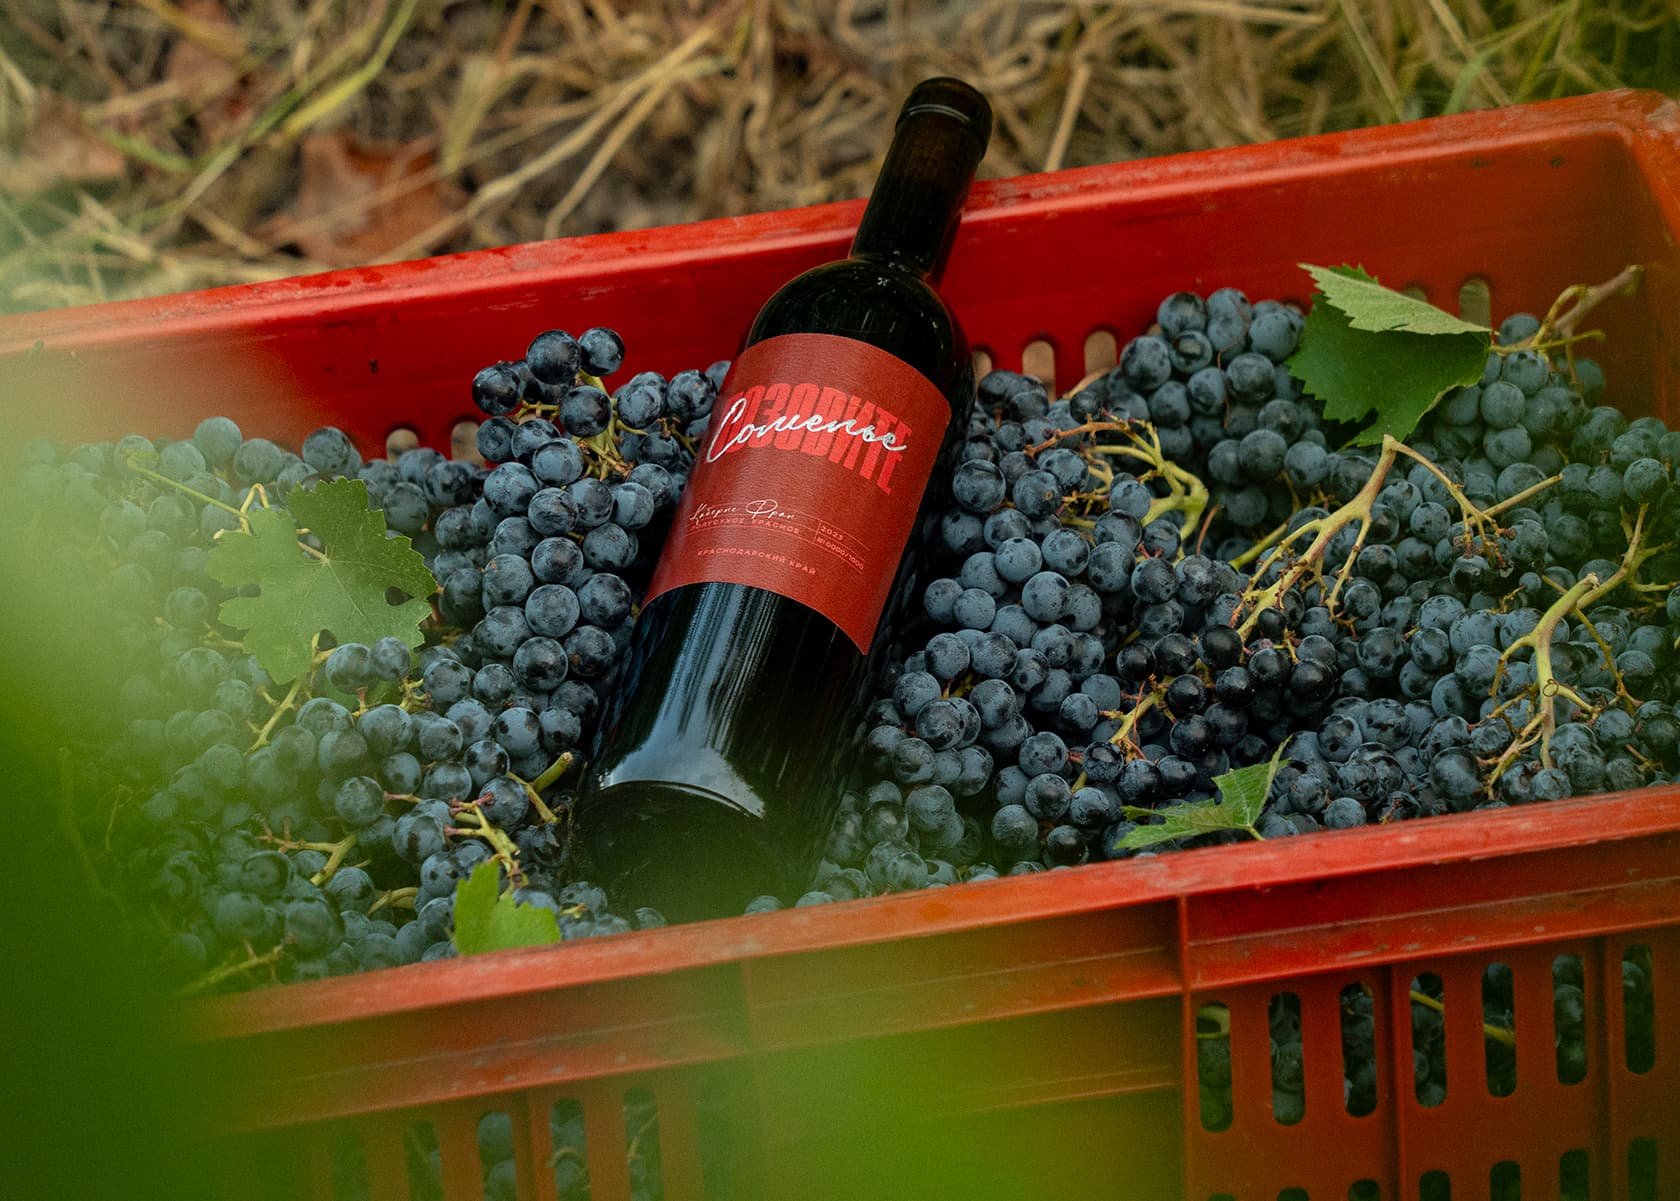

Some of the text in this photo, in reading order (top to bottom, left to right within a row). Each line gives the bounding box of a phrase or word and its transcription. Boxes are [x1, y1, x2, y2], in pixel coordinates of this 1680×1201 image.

[706, 397, 907, 463] Сомелье
[751, 518, 801, 534] КРАСНОЕ
[820, 526, 844, 541] 2023
[697, 547, 816, 575] КРАСНОДАРСКИЙ КРАЙ
